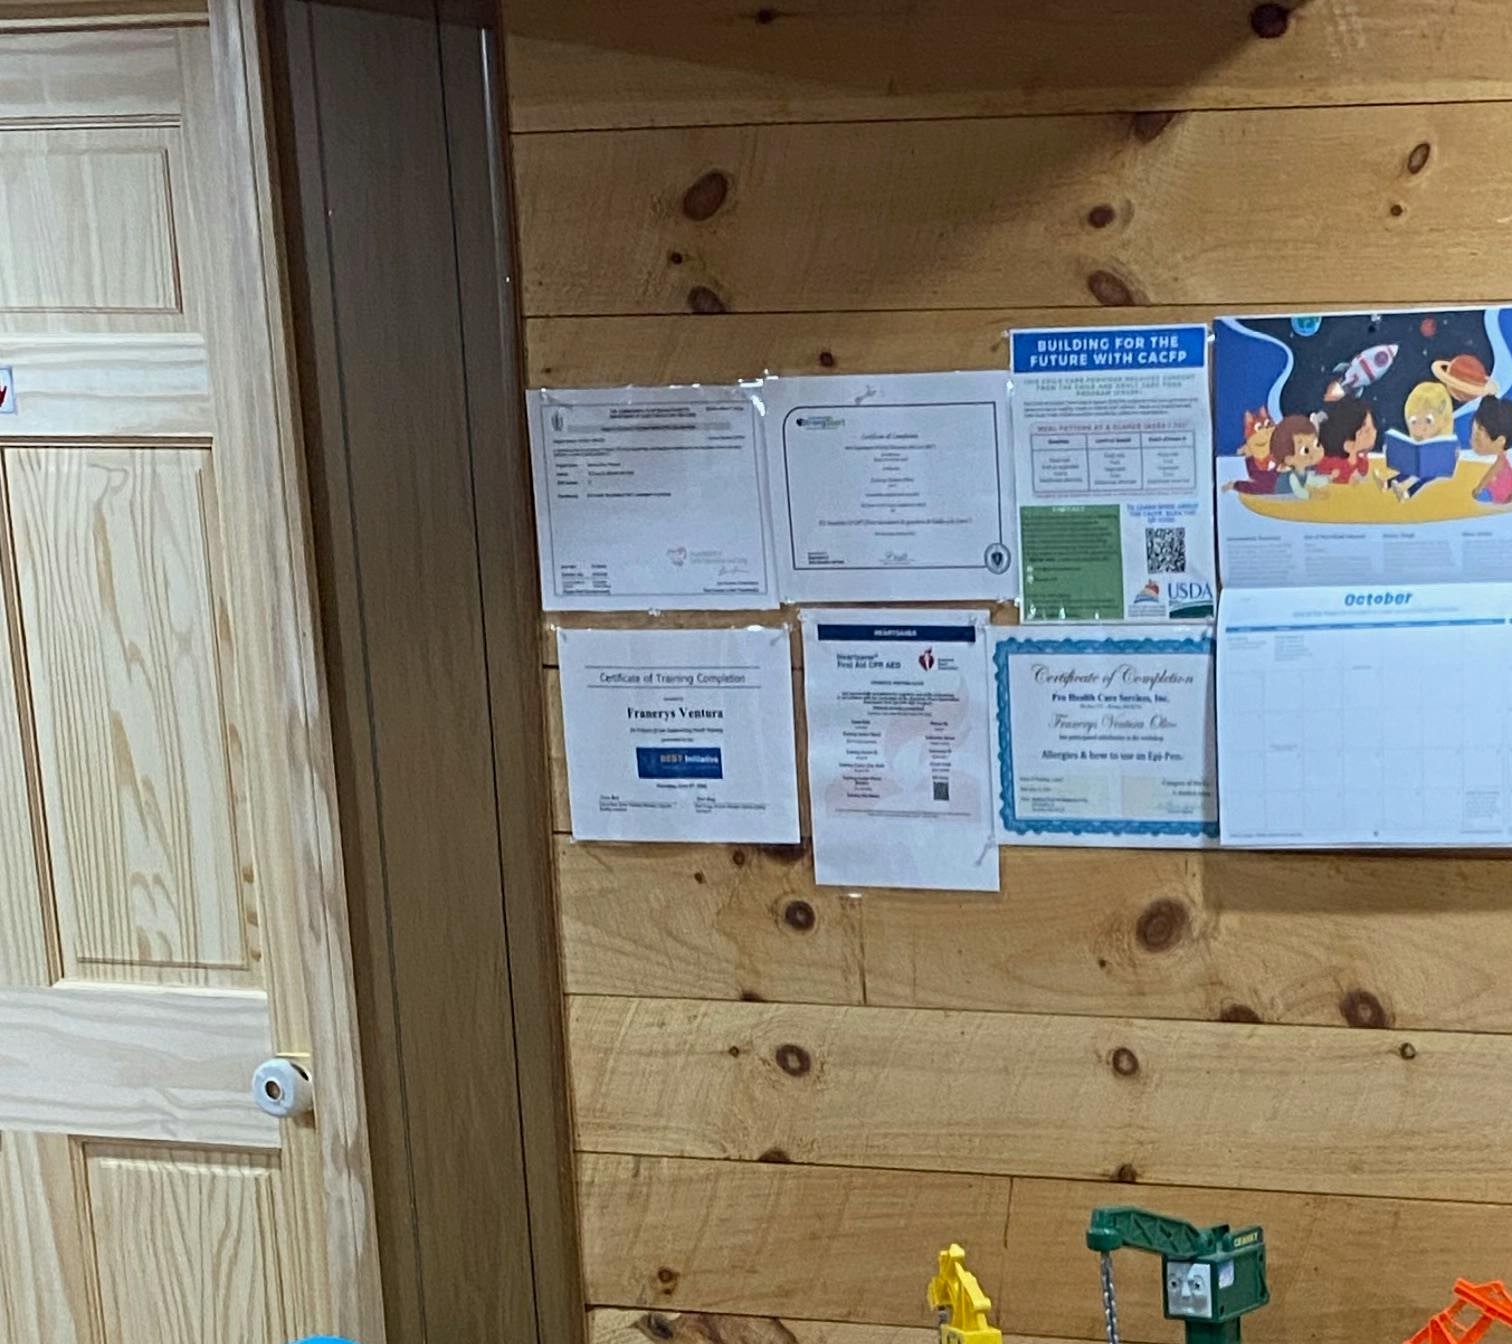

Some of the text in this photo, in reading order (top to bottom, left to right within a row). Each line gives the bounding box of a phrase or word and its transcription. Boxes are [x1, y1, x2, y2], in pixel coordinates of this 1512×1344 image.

[1037, 335, 1179, 353] BUILDING FOR THE
[1030, 350, 1188, 367] FUTURE WITH CACFP
[1167, 582, 1213, 600] USDA
[1344, 591, 1413, 608] October
[599, 672, 746, 685] Certificate of Training Completion
[1030, 663, 1194, 691] Certificate of Completion
[1052, 693, 1067, 702] Pro
[1068, 693, 1095, 702] Health
[1098, 694, 1117, 702] Care
[679, 707, 723, 719] Ventura
[1041, 750, 1078, 762] Allergies
[1080, 750, 1087, 760] &
[1089, 750, 1107, 760] how
[1109, 751, 1120, 760] to
[1136, 753, 1147, 761] an
